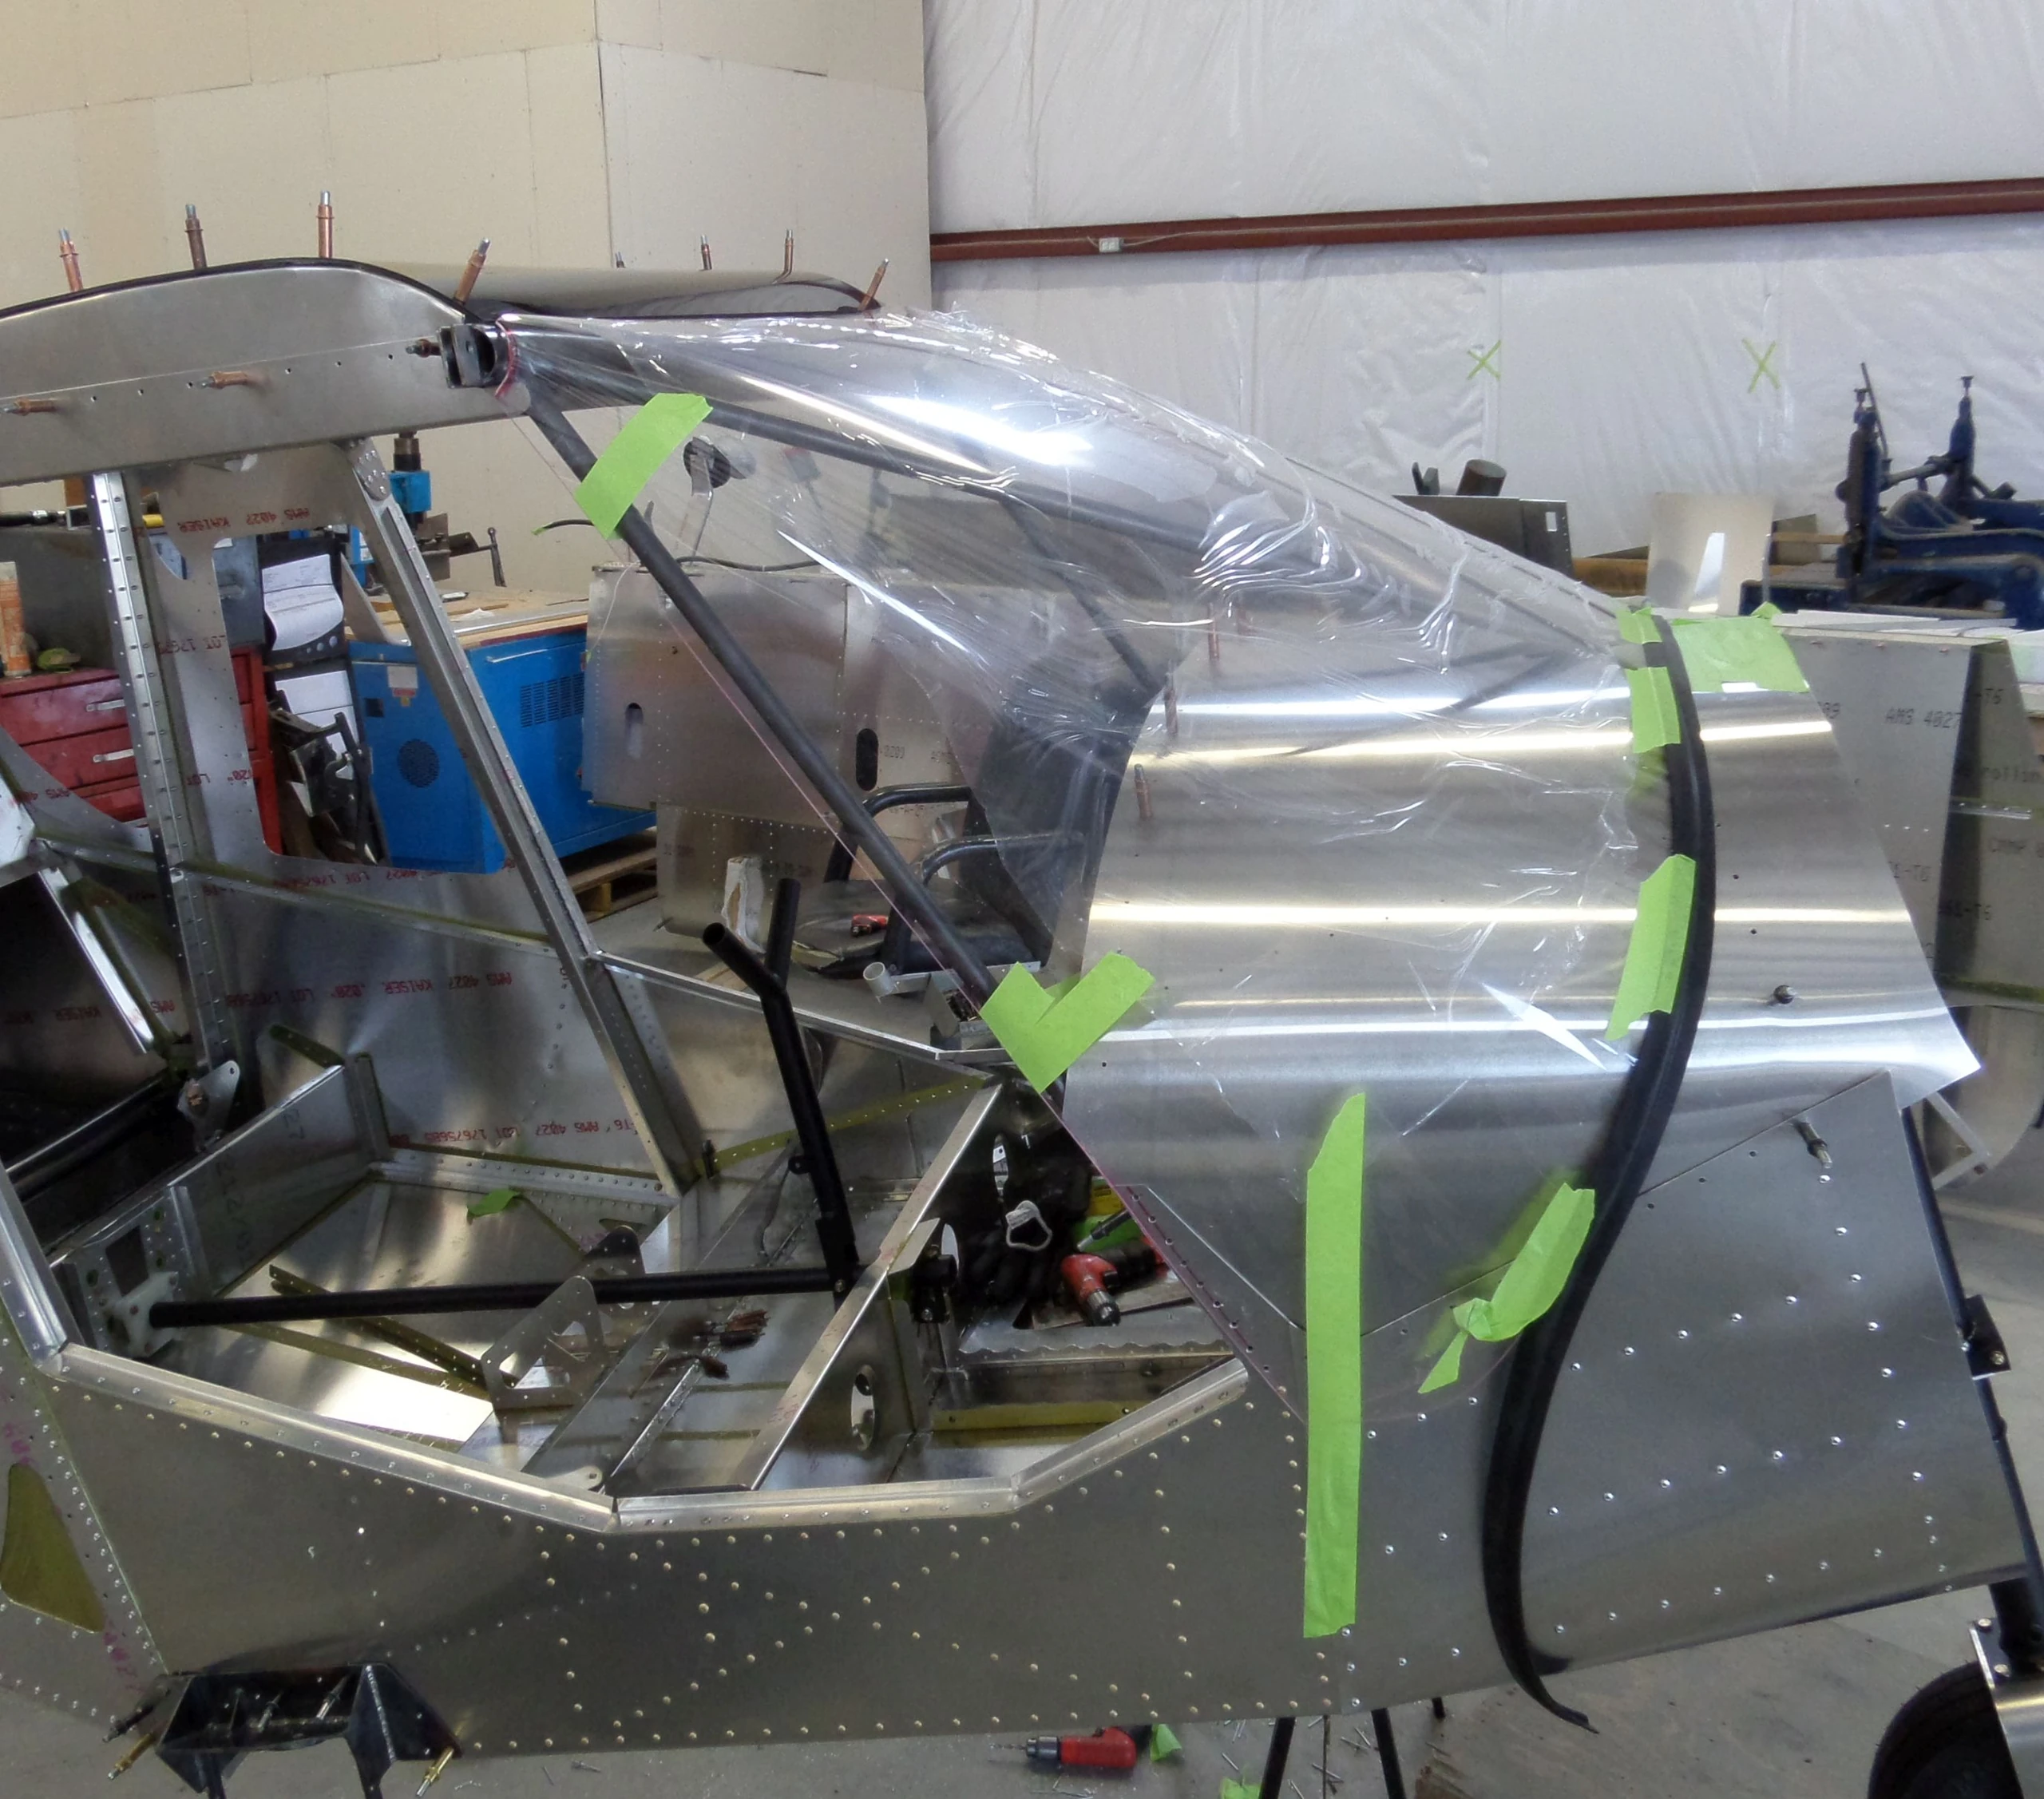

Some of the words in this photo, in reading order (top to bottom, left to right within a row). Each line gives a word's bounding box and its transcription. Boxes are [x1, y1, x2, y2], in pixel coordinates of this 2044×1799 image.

[245, 510, 278, 525] 4027
[283, 507, 310, 521] AMS
[176, 516, 232, 533] KAISER
[201, 634, 227, 649] LOT
[1885, 707, 1915, 725] AMS
[381, 978, 434, 995] KAISER
[449, 973, 480, 990] 4027
[485, 972, 513, 988] AMS
[291, 987, 315, 1003] LOT
[149, 999, 176, 1015] AMS
[493, 1126, 521, 1142] LOT
[535, 1122, 567, 1137] 4027
[573, 1120, 600, 1134] AMS
